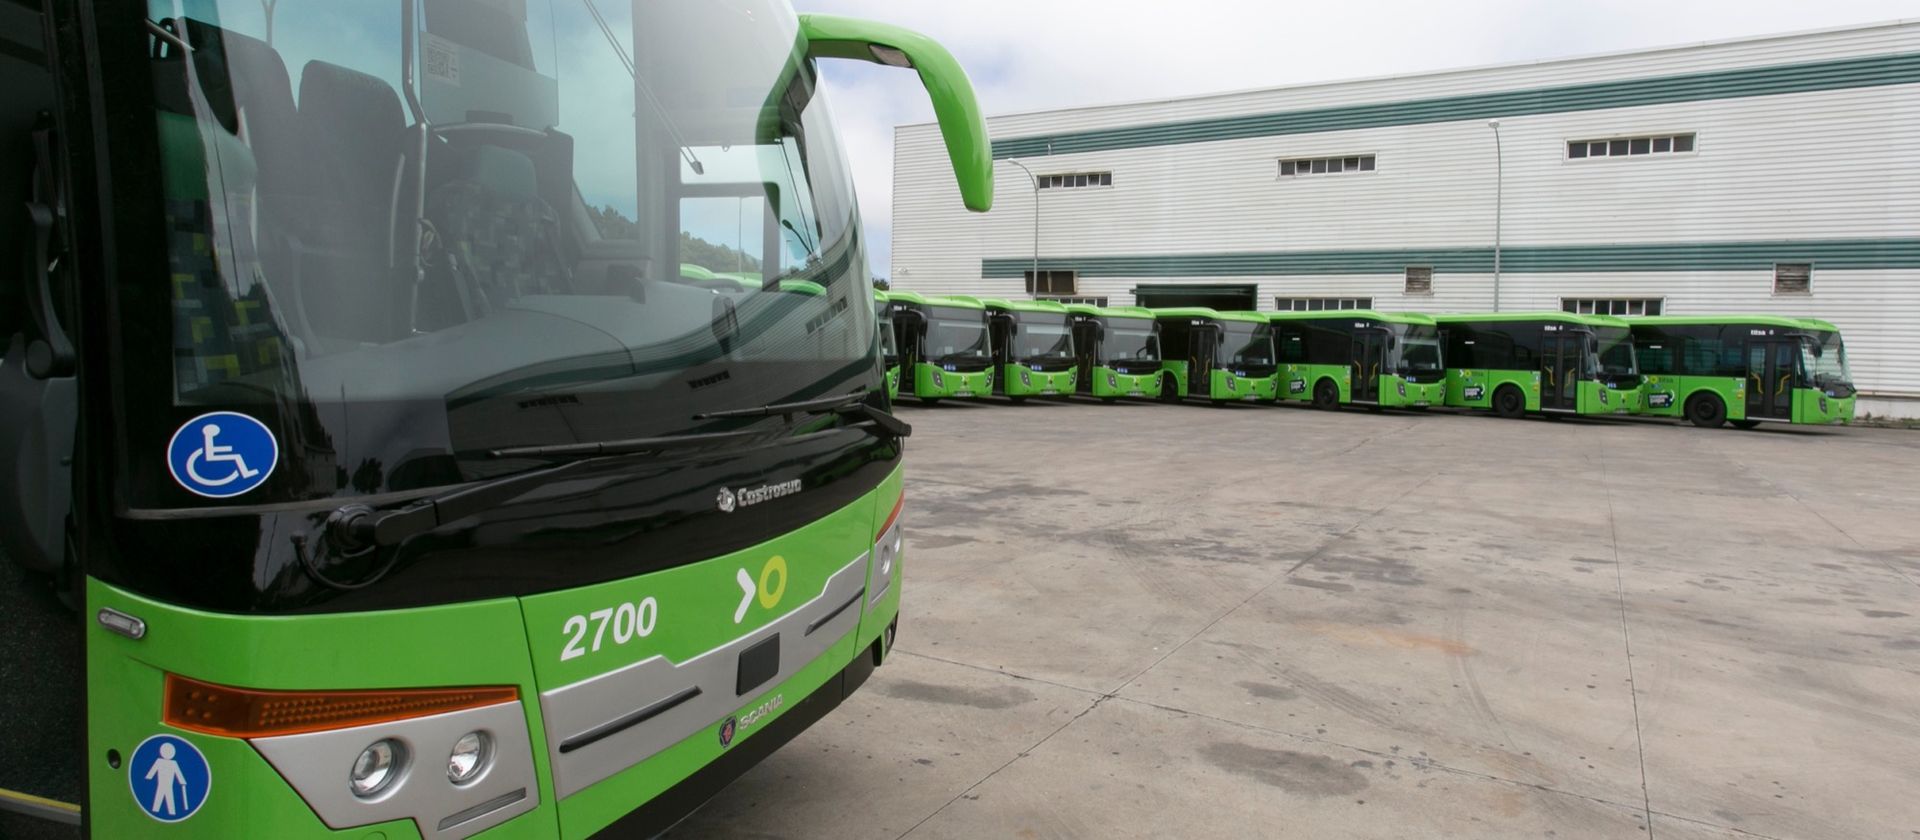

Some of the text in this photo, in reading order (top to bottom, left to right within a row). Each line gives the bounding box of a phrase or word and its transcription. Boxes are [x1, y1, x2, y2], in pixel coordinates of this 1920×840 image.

[737, 478, 802, 507] Castrosua
[560, 596, 658, 662] 2700
[739, 693, 783, 730] SCANIA
